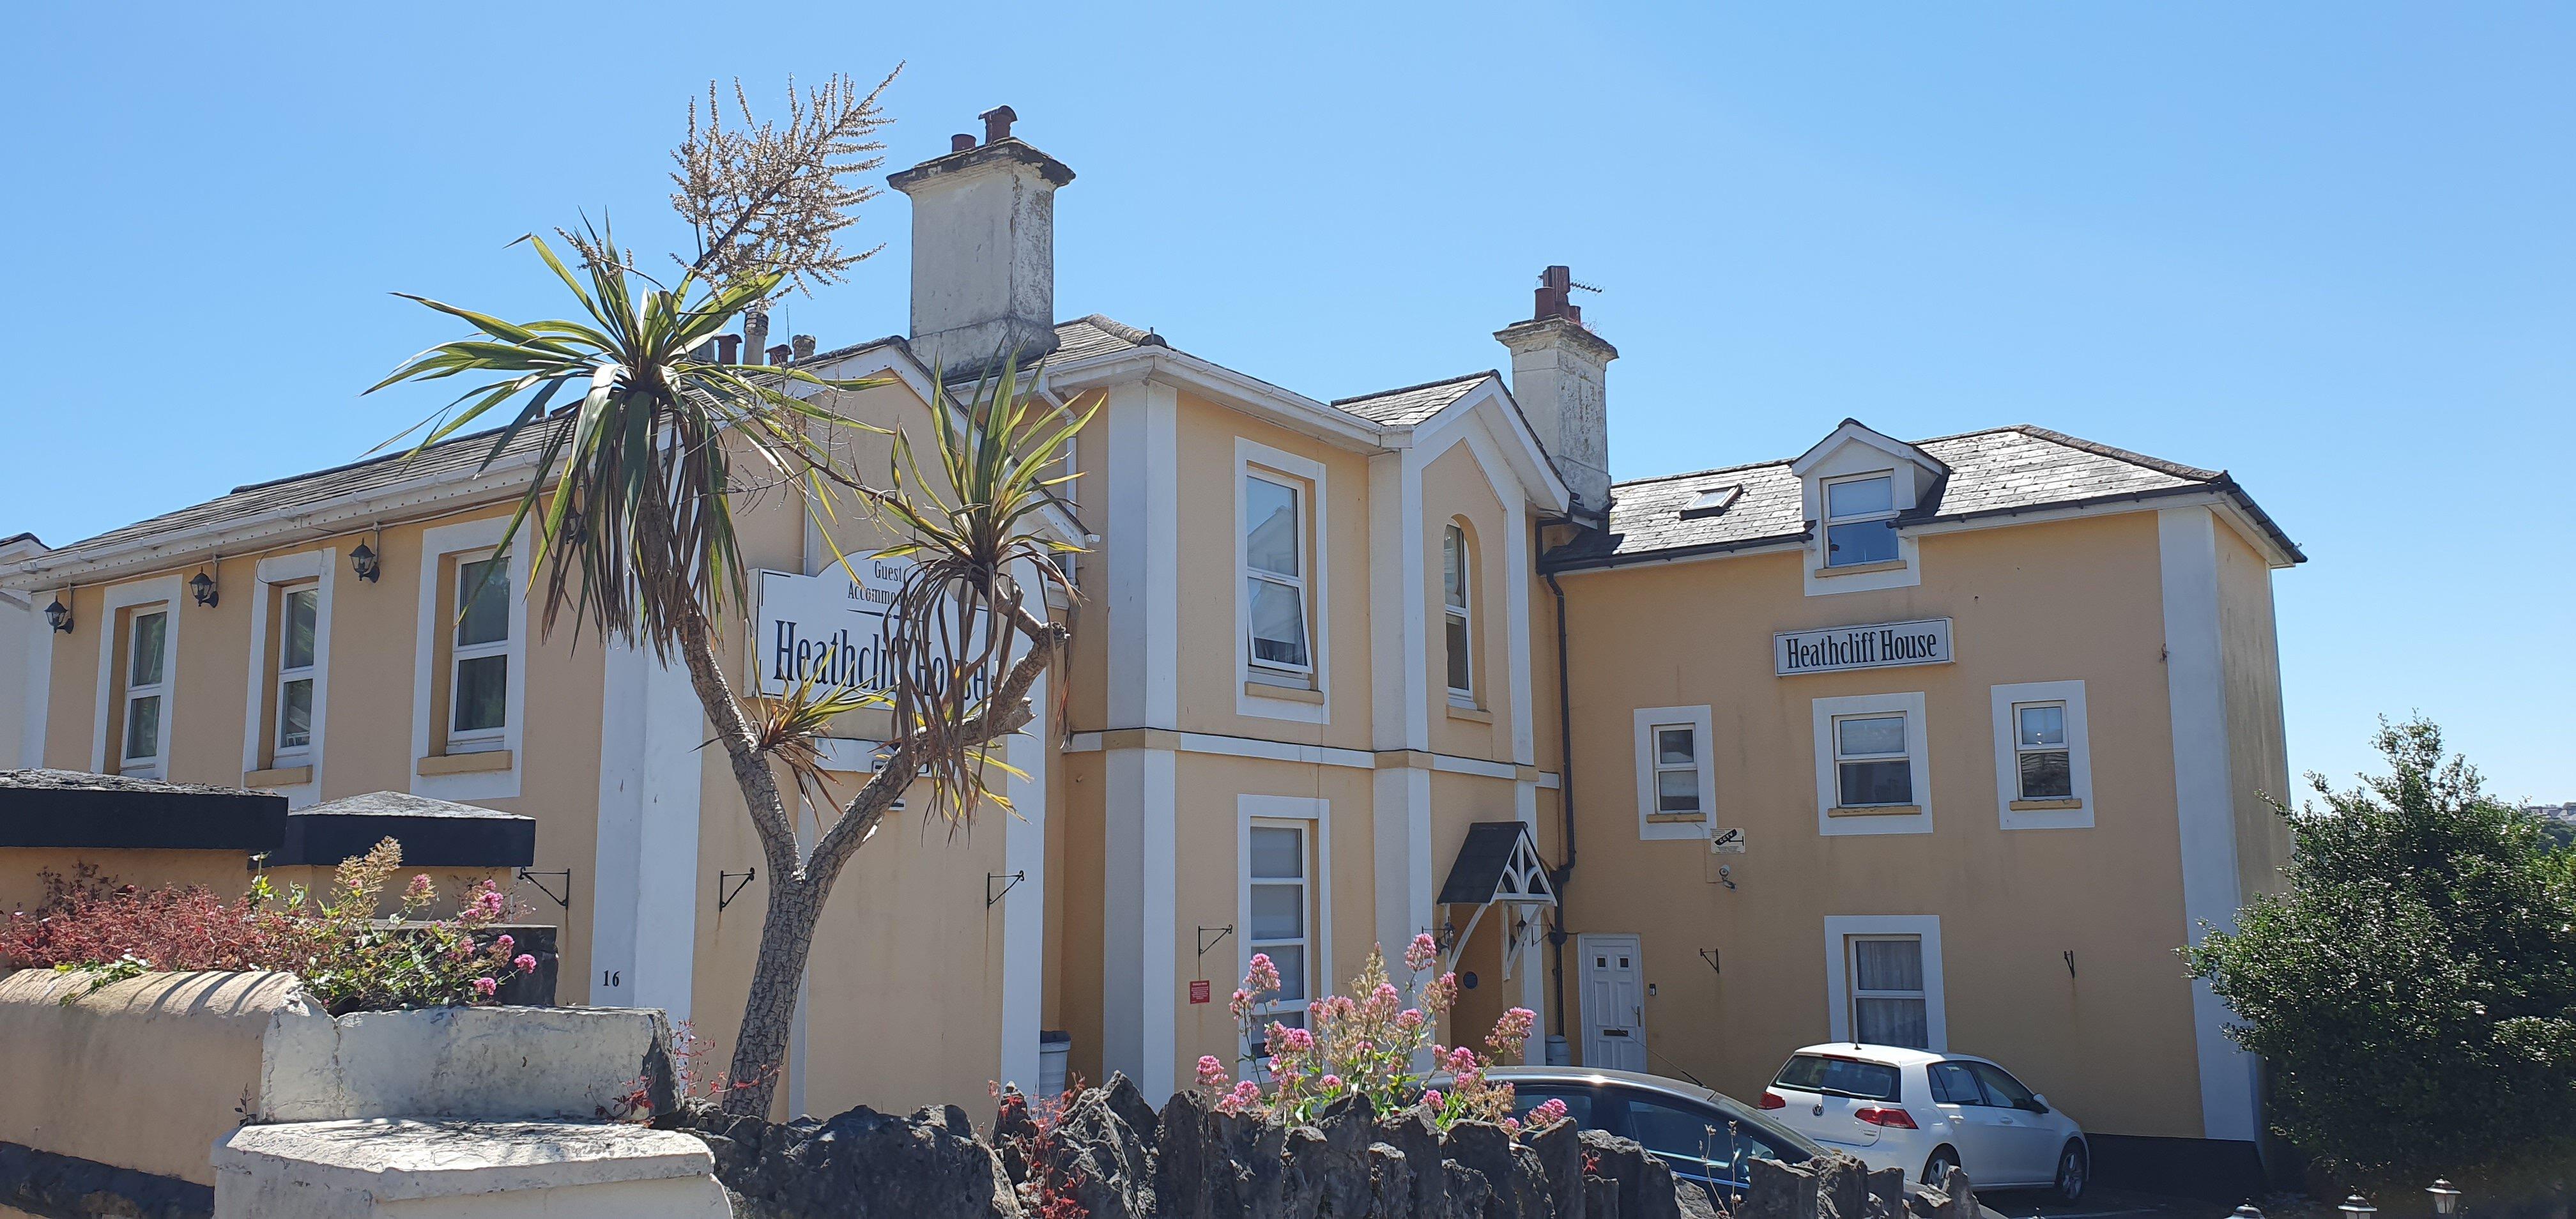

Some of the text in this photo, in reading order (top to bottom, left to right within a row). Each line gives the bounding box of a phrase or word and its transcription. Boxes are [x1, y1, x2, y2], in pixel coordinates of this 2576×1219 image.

[874, 560, 902, 582] Guest
[772, 620, 909, 693] Heathclif
[1786, 629, 1936, 669] Heathcliff House
[1719, 832, 1733, 843] CCTV
[602, 970, 620, 987] 16
